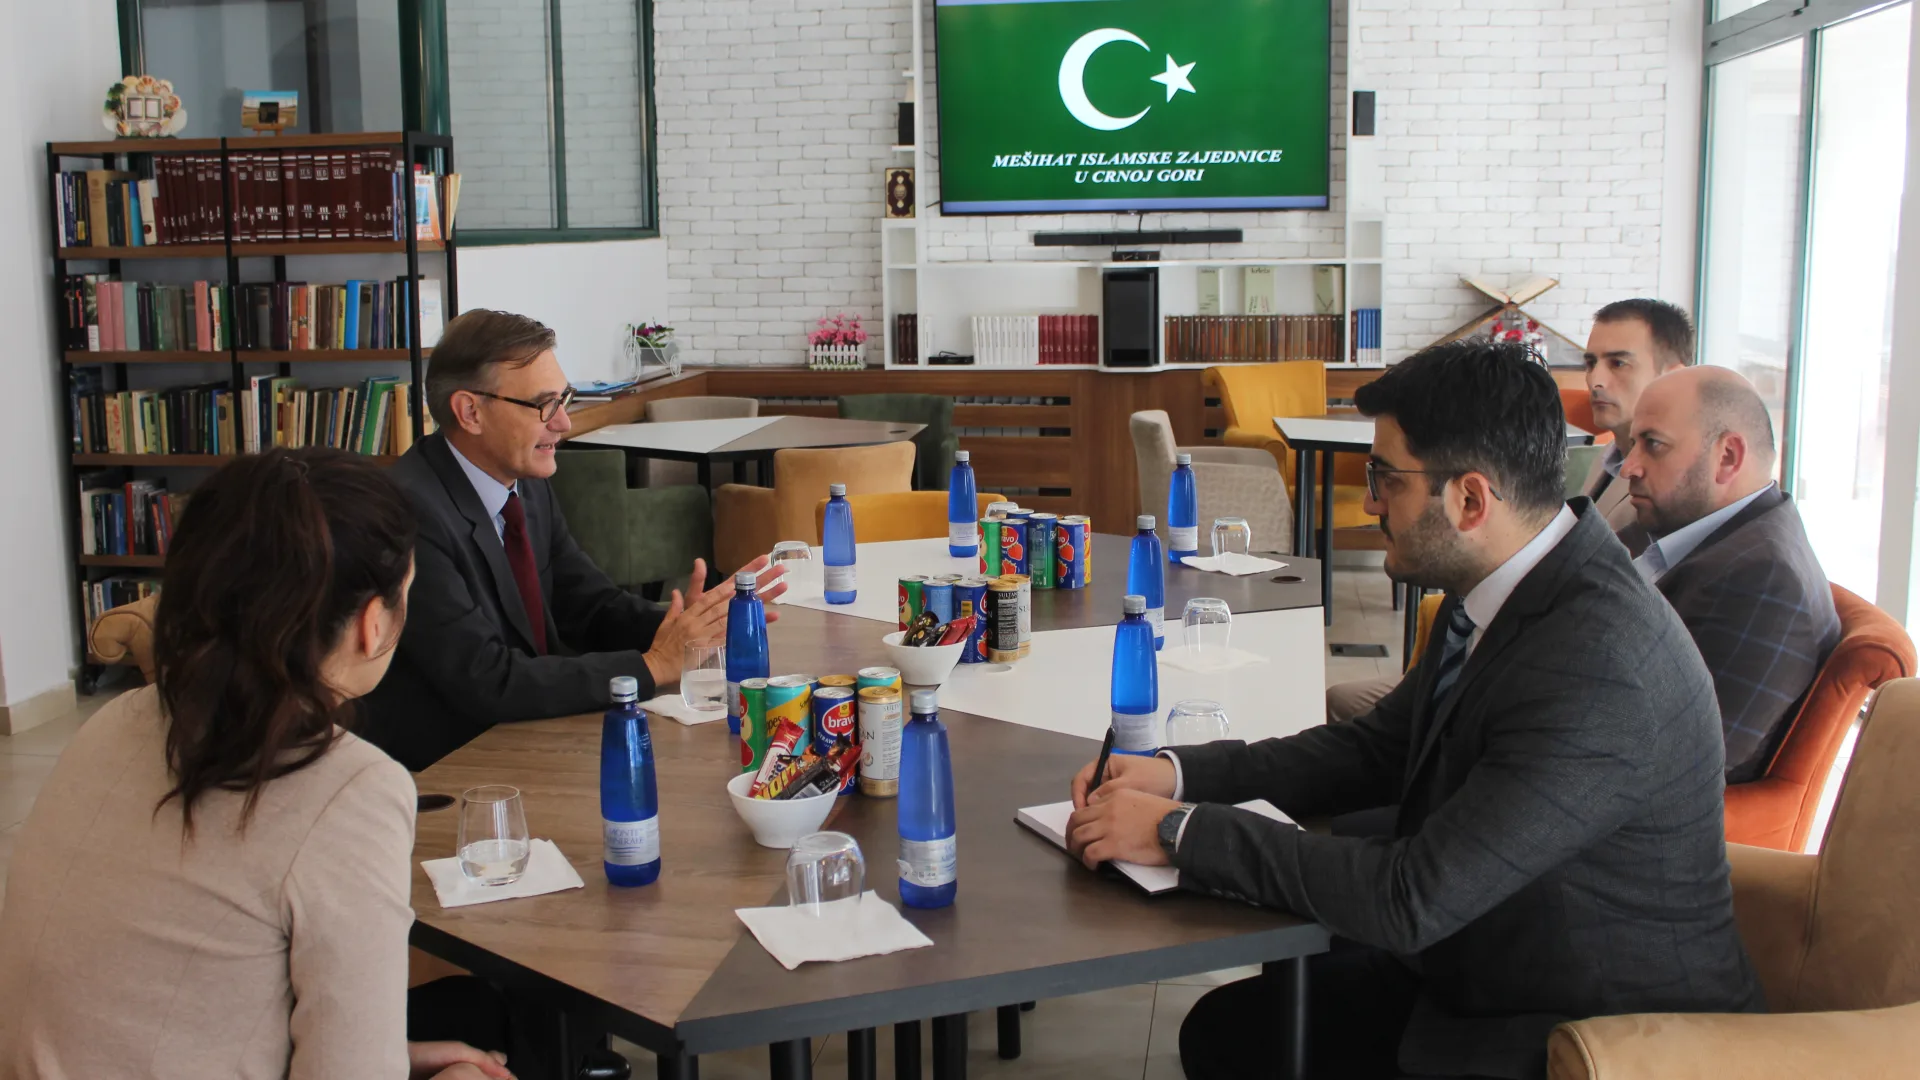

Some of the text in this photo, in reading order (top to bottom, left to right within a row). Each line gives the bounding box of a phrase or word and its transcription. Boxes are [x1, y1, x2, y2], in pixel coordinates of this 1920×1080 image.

[992, 149, 1283, 168] MEŠIHAT ISLAMSKE ZAJEDNICE
[1074, 168, 1205, 184] U CRNOJ GORI
[828, 714, 855, 728] brav
